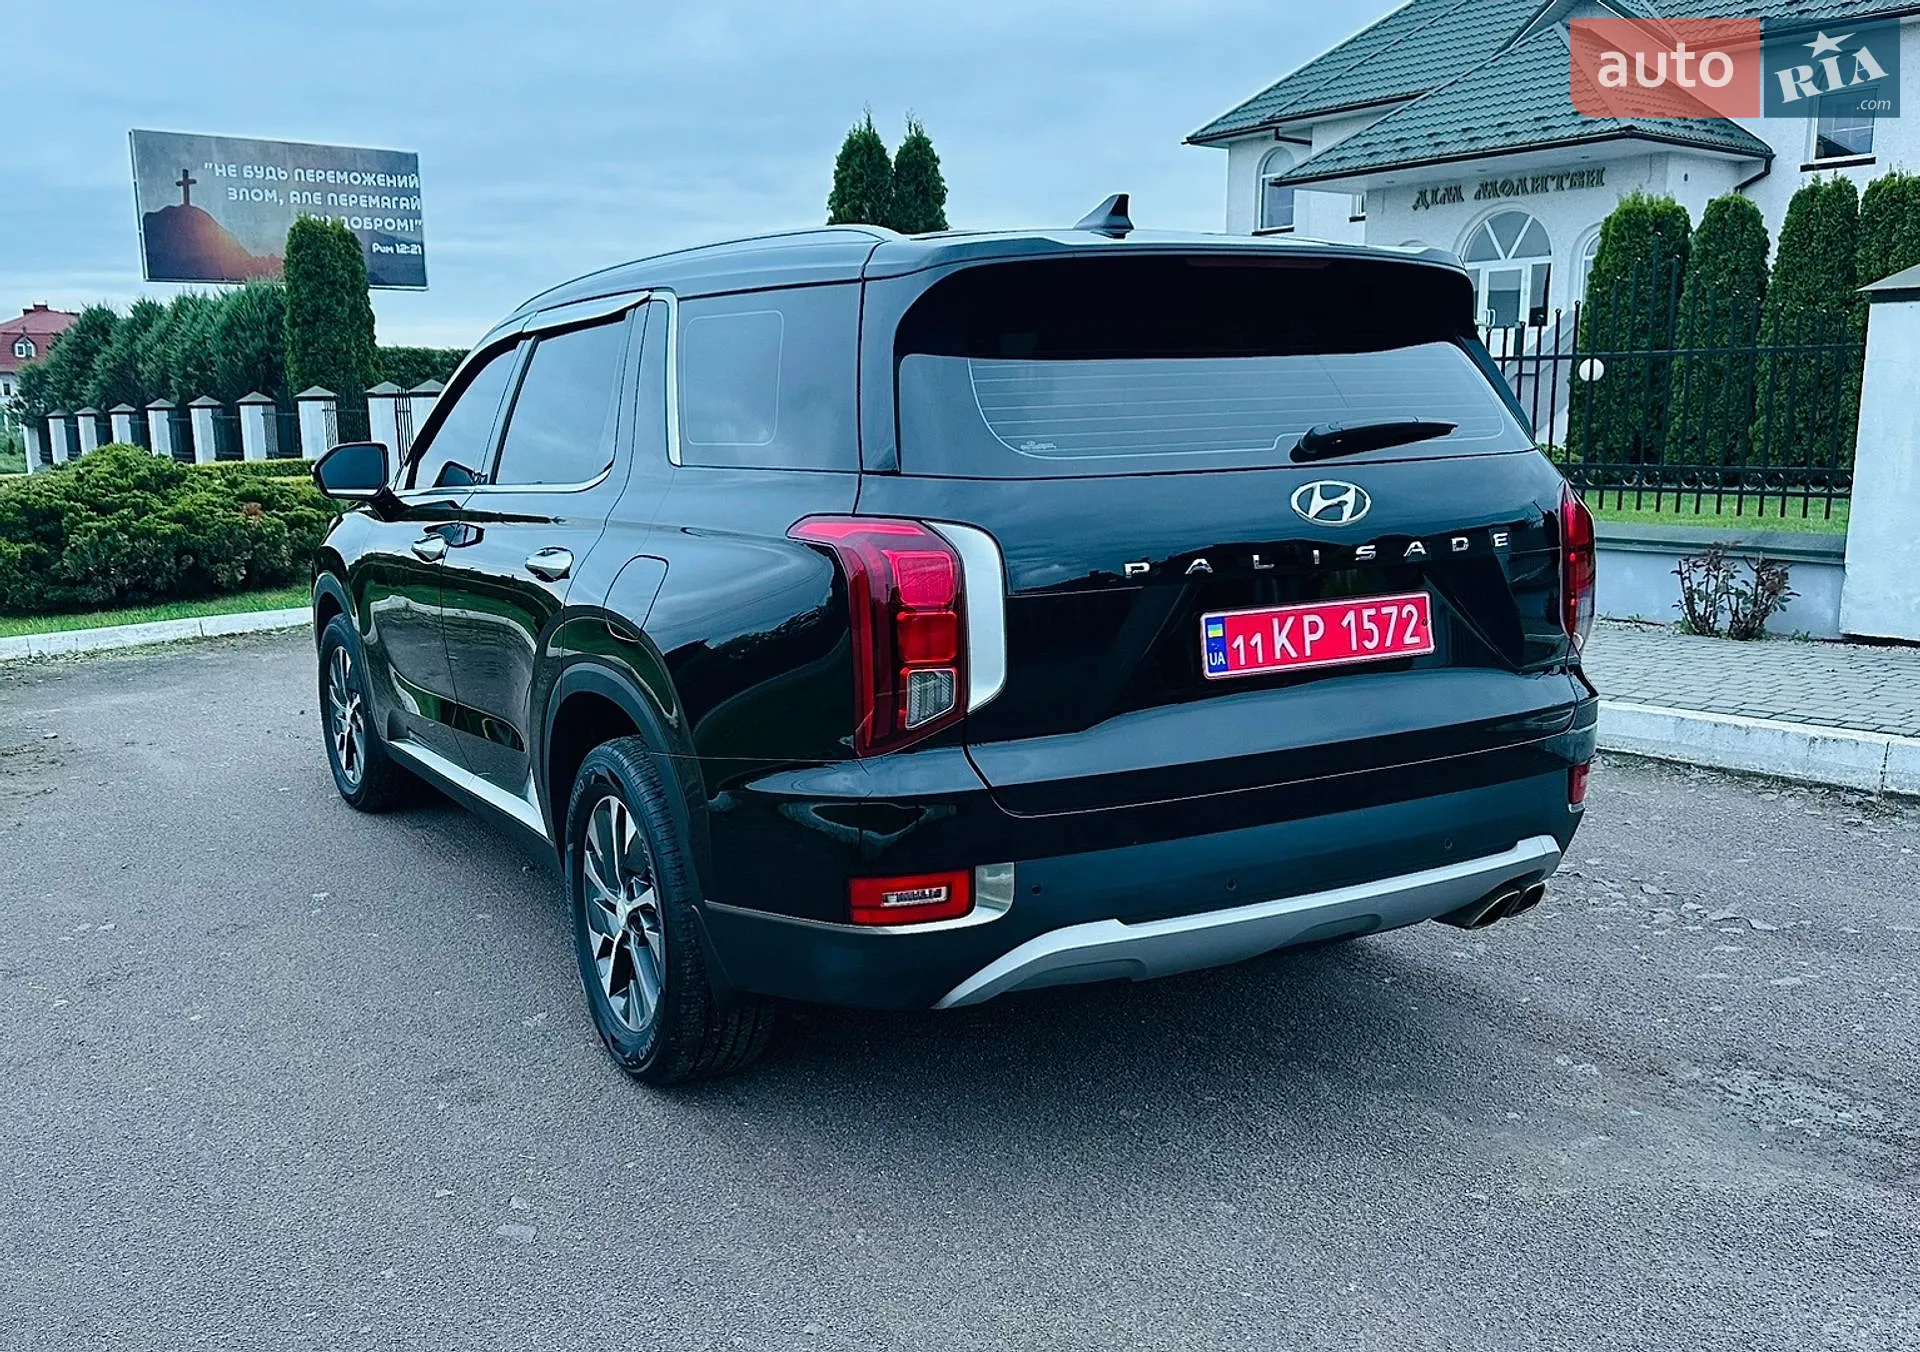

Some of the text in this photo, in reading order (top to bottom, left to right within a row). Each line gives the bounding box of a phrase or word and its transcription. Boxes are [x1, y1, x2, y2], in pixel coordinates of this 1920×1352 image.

[242, 165, 288, 181] БУДЬ
[293, 167, 420, 188] ПЕРЕМОЖЕНИЙ
[227, 187, 421, 210] ЗЛОМ, АЛЕ ПЕРЕМАГАЙ
[394, 242, 422, 256] 12:21
[1124, 532, 1510, 579] PALISADE
[1340, 604, 1421, 651] 1572
[1209, 651, 1226, 666] UA
